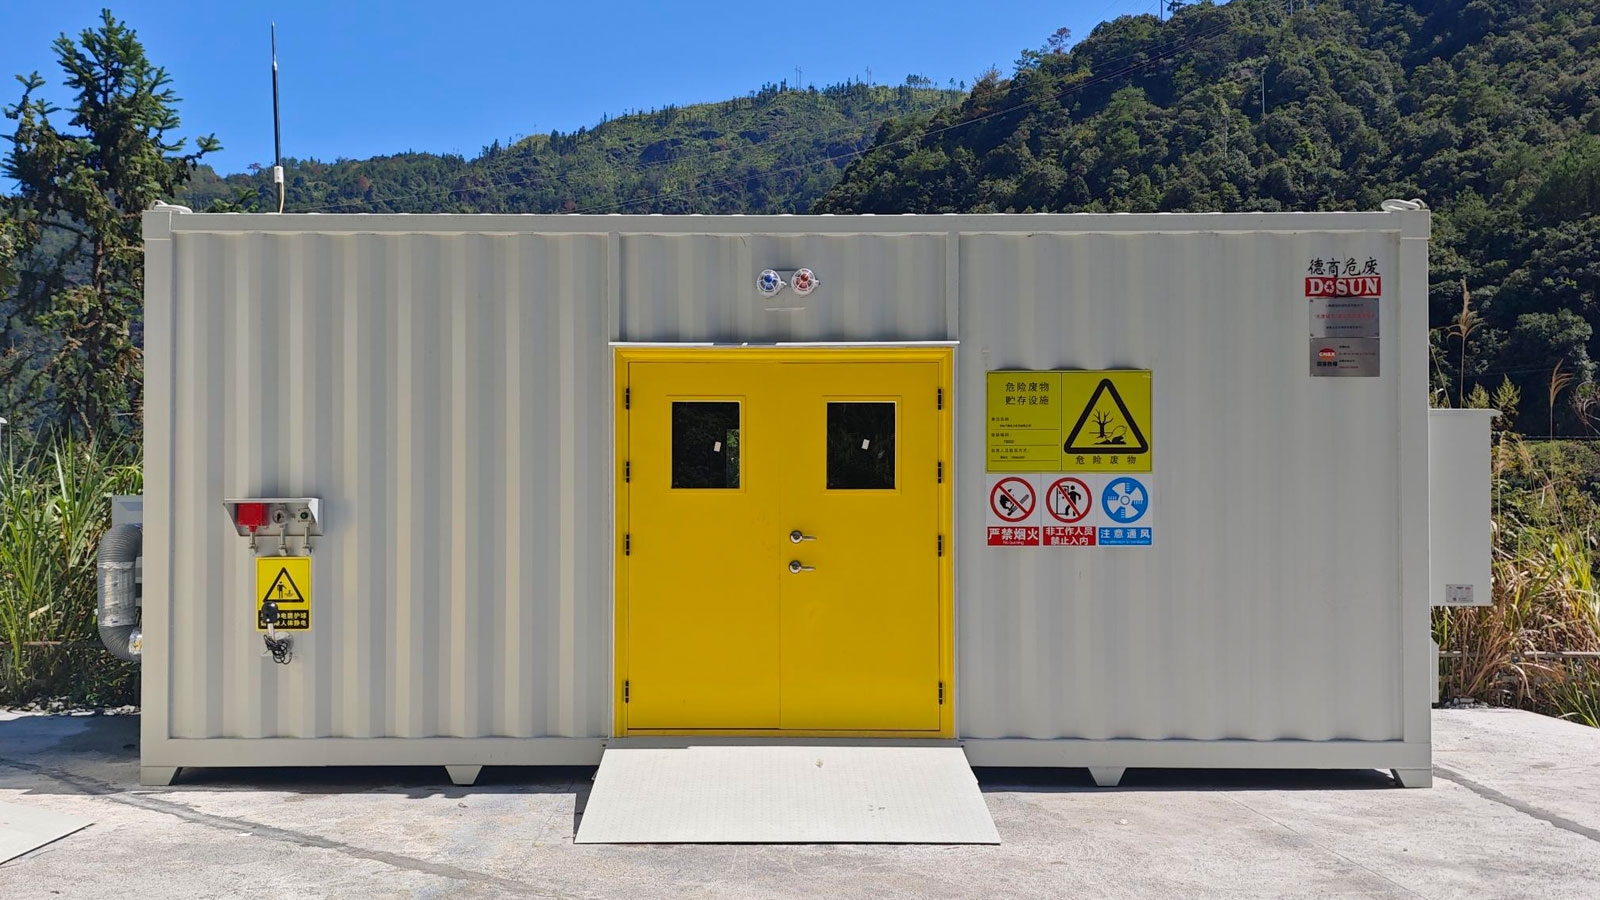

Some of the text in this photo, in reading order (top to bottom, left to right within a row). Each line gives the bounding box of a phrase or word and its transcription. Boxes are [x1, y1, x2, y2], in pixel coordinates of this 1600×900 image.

[1308, 257, 1380, 277] 德商危废
[1005, 382, 1049, 392] 危险废物
[1005, 396, 1049, 405] 贮存设施
[1076, 456, 1136, 464] 危险废物
[988, 528, 1038, 540] 严禁烟火
[1045, 526, 1093, 536] 非工作人员
[1100, 529, 1150, 538] 注意通风
[1051, 536, 1089, 545] 禁止入内
